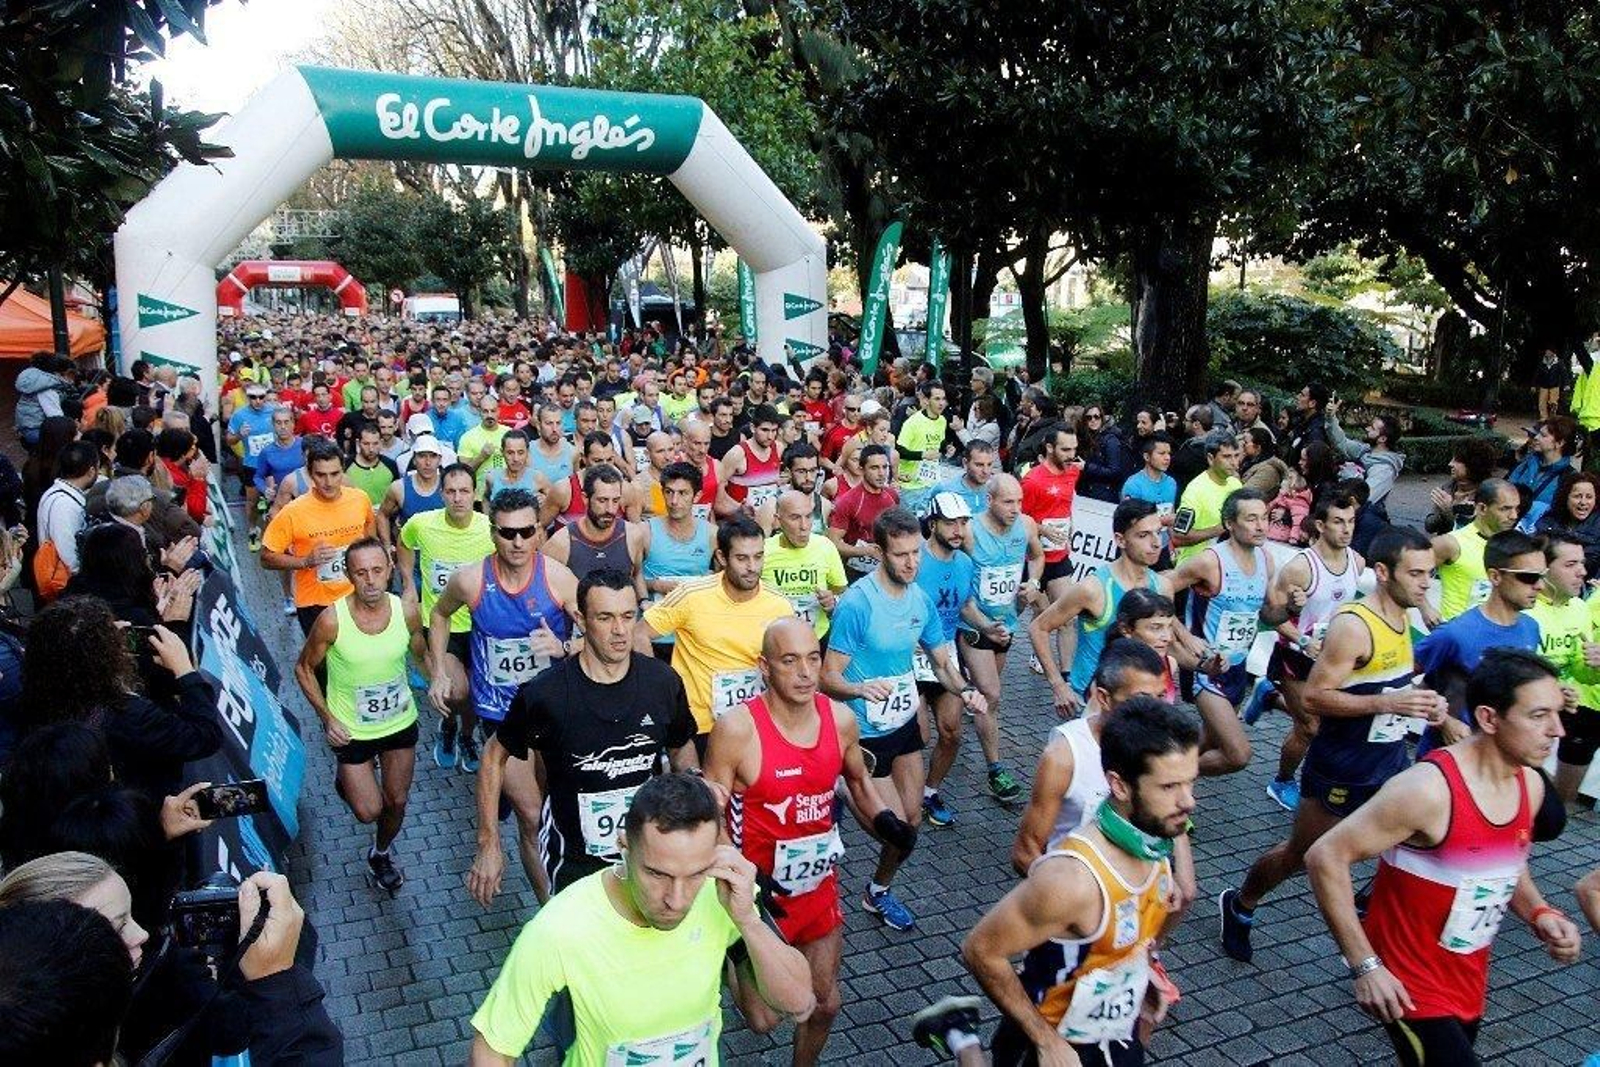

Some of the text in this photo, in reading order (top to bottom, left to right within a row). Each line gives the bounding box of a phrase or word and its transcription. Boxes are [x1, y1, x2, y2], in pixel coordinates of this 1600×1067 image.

[376, 93, 656, 160] El Corte Inglés
[870, 242, 893, 301] Inglés
[864, 303, 880, 341] Corte
[989, 580, 1016, 596] 500
[499, 654, 539, 673] 461
[880, 693, 911, 715] 745
